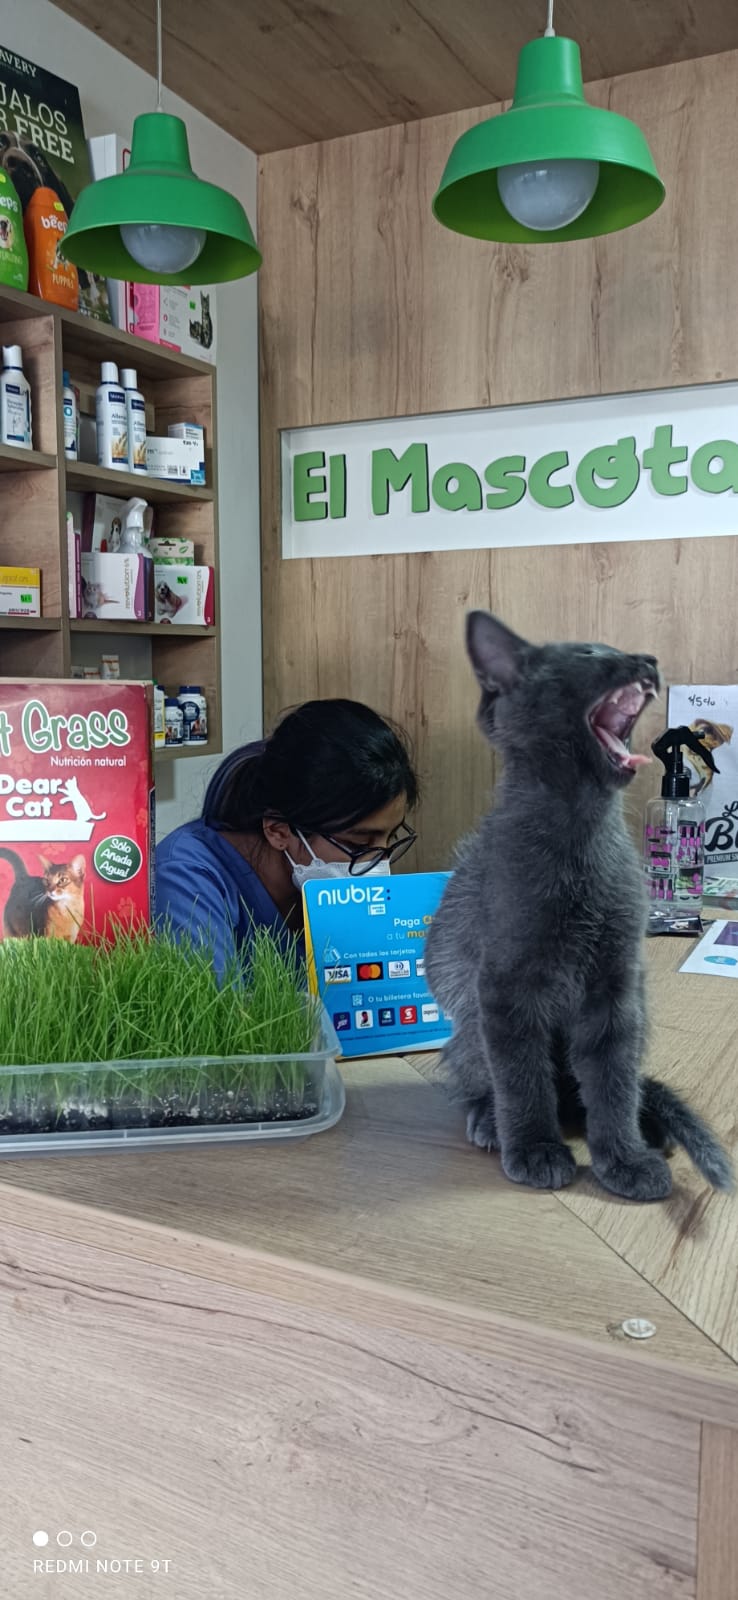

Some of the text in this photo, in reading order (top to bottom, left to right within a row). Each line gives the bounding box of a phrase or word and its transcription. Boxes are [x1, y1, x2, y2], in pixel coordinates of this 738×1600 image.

[13, 114, 75, 165] FREE
[293, 424, 738, 522] El Mascota
[21, 699, 131, 754] Grass
[51, 754, 127, 767] Nutrición natural
[0, 773, 63, 795] Dear
[5, 796, 54, 818] Cat
[706, 854, 731, 864] PREMIUM
[99, 861, 130, 877] Agua!
[393, 917, 420, 929] Paga
[386, 933, 393, 941] a
[395, 932, 405, 941] tu
[389, 948, 416, 958] tarjetas
[328, 969, 350, 980] VISA
[383, 993, 412, 1001] billetera
